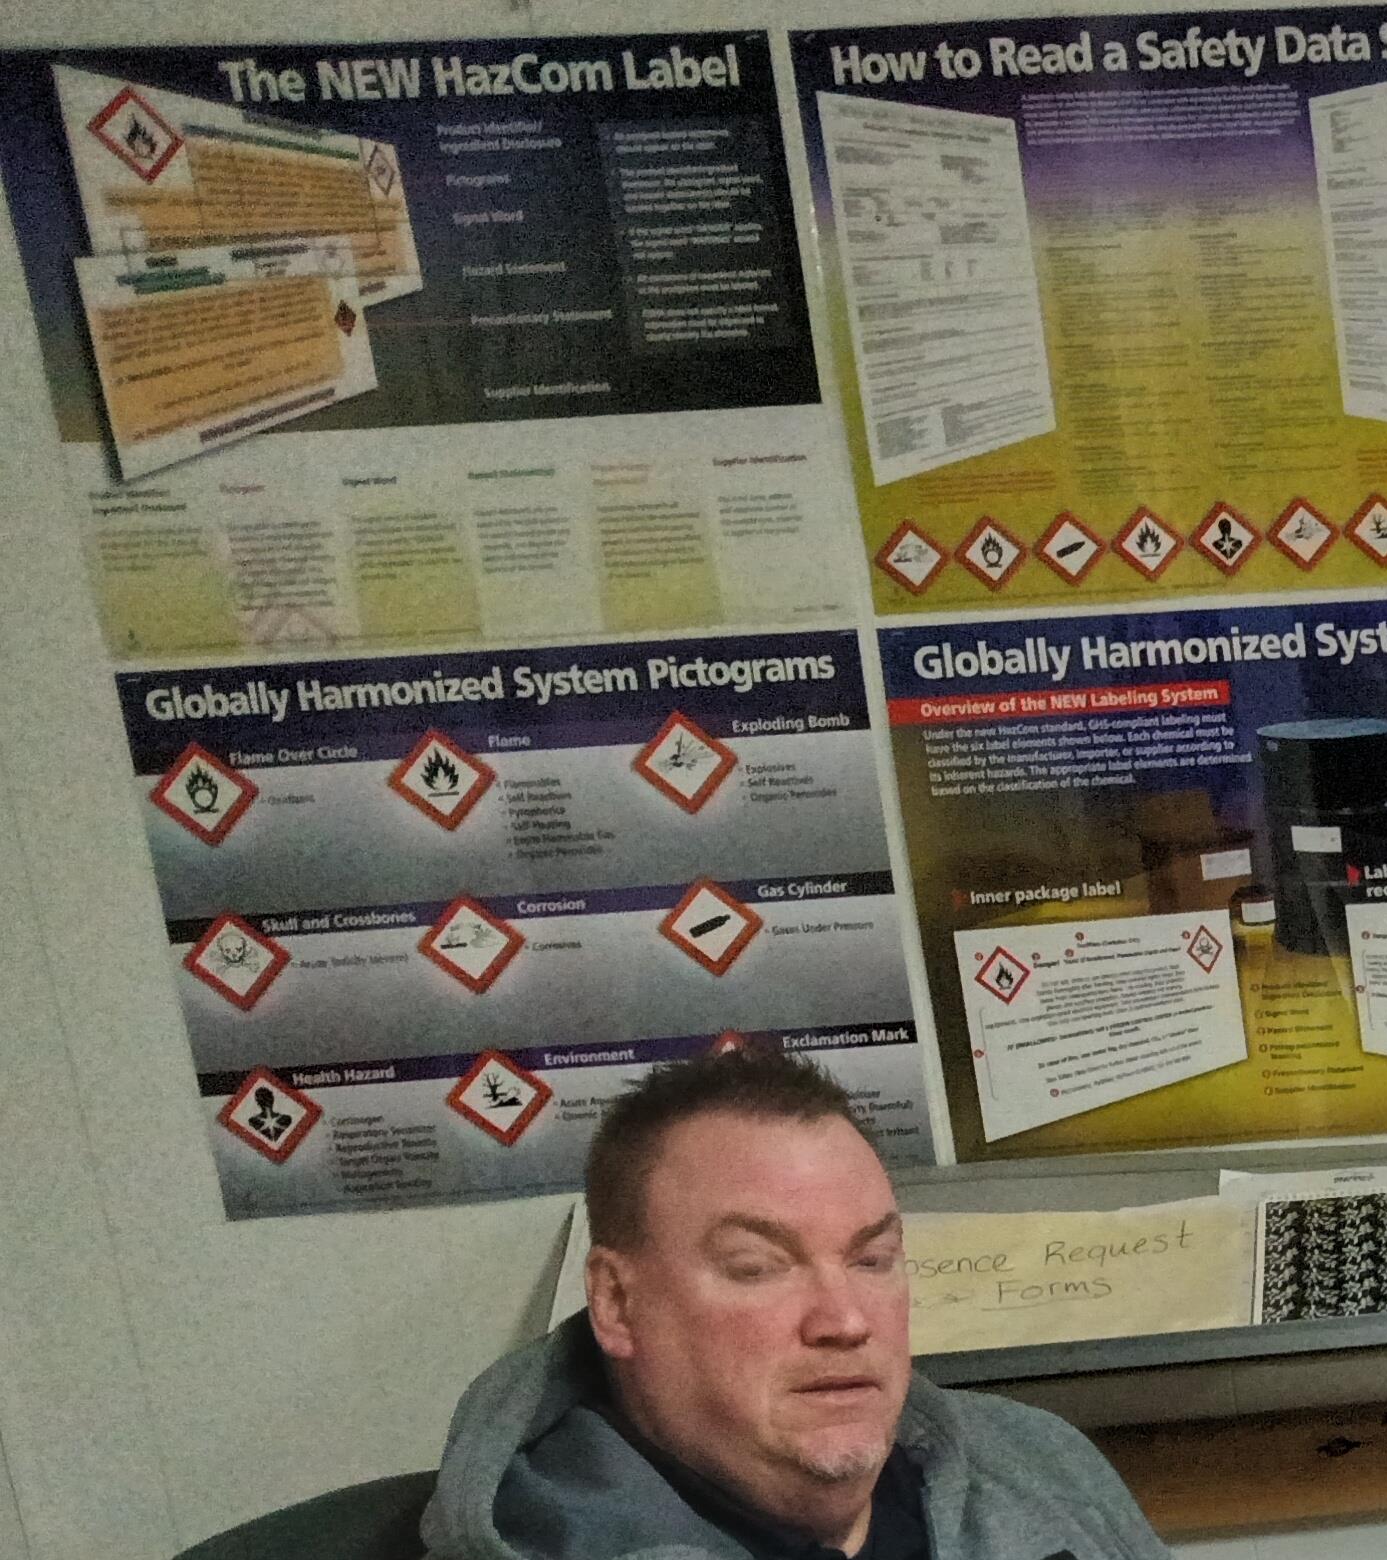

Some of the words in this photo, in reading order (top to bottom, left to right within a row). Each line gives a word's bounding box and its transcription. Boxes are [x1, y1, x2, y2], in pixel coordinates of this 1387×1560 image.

[831, 45, 926, 85] How
[934, 42, 982, 79] to
[993, 32, 1093, 76] Read
[1103, 42, 1128, 71] a
[1137, 28, 1265, 76] Safety
[1277, 26, 1371, 64] Data
[218, 59, 304, 101] The
[317, 58, 420, 99] NEW
[433, 53, 613, 97] HazCom
[622, 44, 740, 91] Label
[914, 635, 1070, 681] Globally
[1082, 624, 1306, 670] Harmonized
[145, 681, 289, 722] Globally
[297, 668, 503, 713] Harmonized
[514, 662, 638, 704] System
[648, 652, 834, 694] Pictograms
[920, 700, 995, 717] Overview
[1000, 697, 1017, 713] of
[1021, 697, 1046, 712] the
[1050, 694, 1087, 710] NEW
[1091, 689, 1158, 707] Labeling
[1161, 688, 1218, 706] System
[732, 717, 804, 734] Exploding
[808, 713, 849, 728] Bomb
[923, 729, 954, 740] Under
[956, 727, 972, 738] the
[1202, 712, 1226, 723] must
[488, 734, 531, 747] Flame
[952, 742, 968, 751] the
[970, 741, 984, 751] six
[1152, 727, 1193, 740] chemical
[1196, 727, 1220, 738] must
[1221, 725, 1234, 736] be
[230, 751, 275, 765] Flame
[278, 749, 313, 763] Over
[317, 746, 358, 759] Circle
[974, 754, 987, 767] by
[1223, 740, 1235, 750] to
[1030, 764, 1048, 775] The
[963, 784, 976, 794] on
[1060, 776, 1071, 787] of
[757, 885, 785, 898] Gas
[788, 881, 848, 898] Cylinder
[970, 890, 1011, 905] Inner
[1015, 885, 1078, 904] package
[1082, 880, 1121, 897] label
[517, 900, 585, 916] Corrosion
[262, 918, 298, 933] Skull
[302, 917, 329, 931] and
[333, 911, 416, 928] Crossbones
[783, 1032, 868, 1048] Exclamation
[872, 1028, 909, 1042] Mark
[544, 1050, 635, 1066] Environment
[293, 1070, 341, 1085] Health
[344, 1066, 396, 1081] Hazard
[903, 1253, 1016, 1279] sence
[1044, 1219, 1194, 1267] Request
[996, 1277, 1112, 1304] Forms
